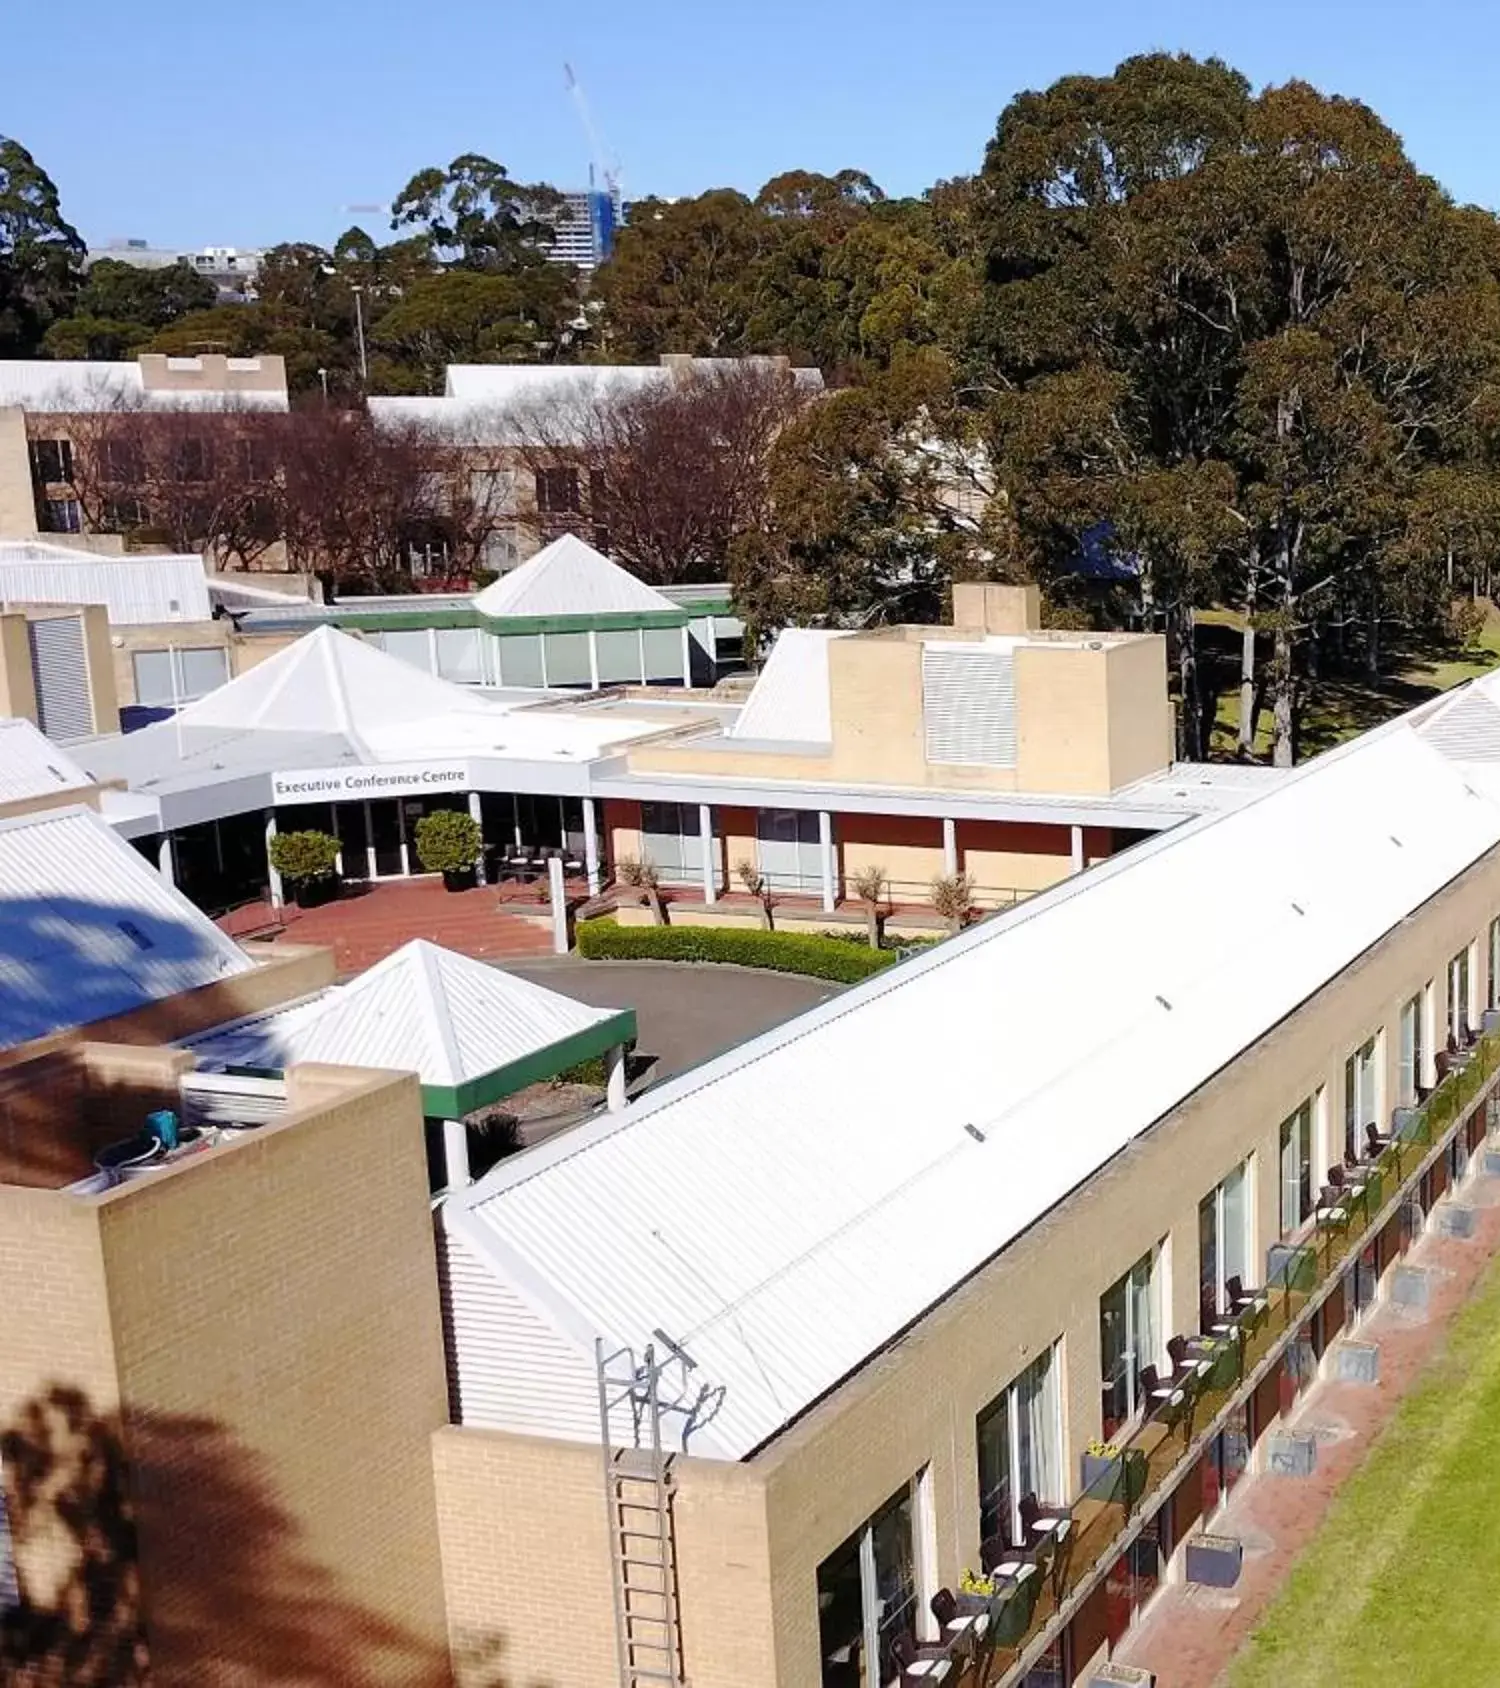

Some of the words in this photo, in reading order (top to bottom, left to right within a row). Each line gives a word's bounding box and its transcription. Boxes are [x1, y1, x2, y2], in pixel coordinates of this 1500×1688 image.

[276, 780, 341, 794] Executive
[345, 774, 419, 789] Conference
[422, 770, 465, 783] Centre
